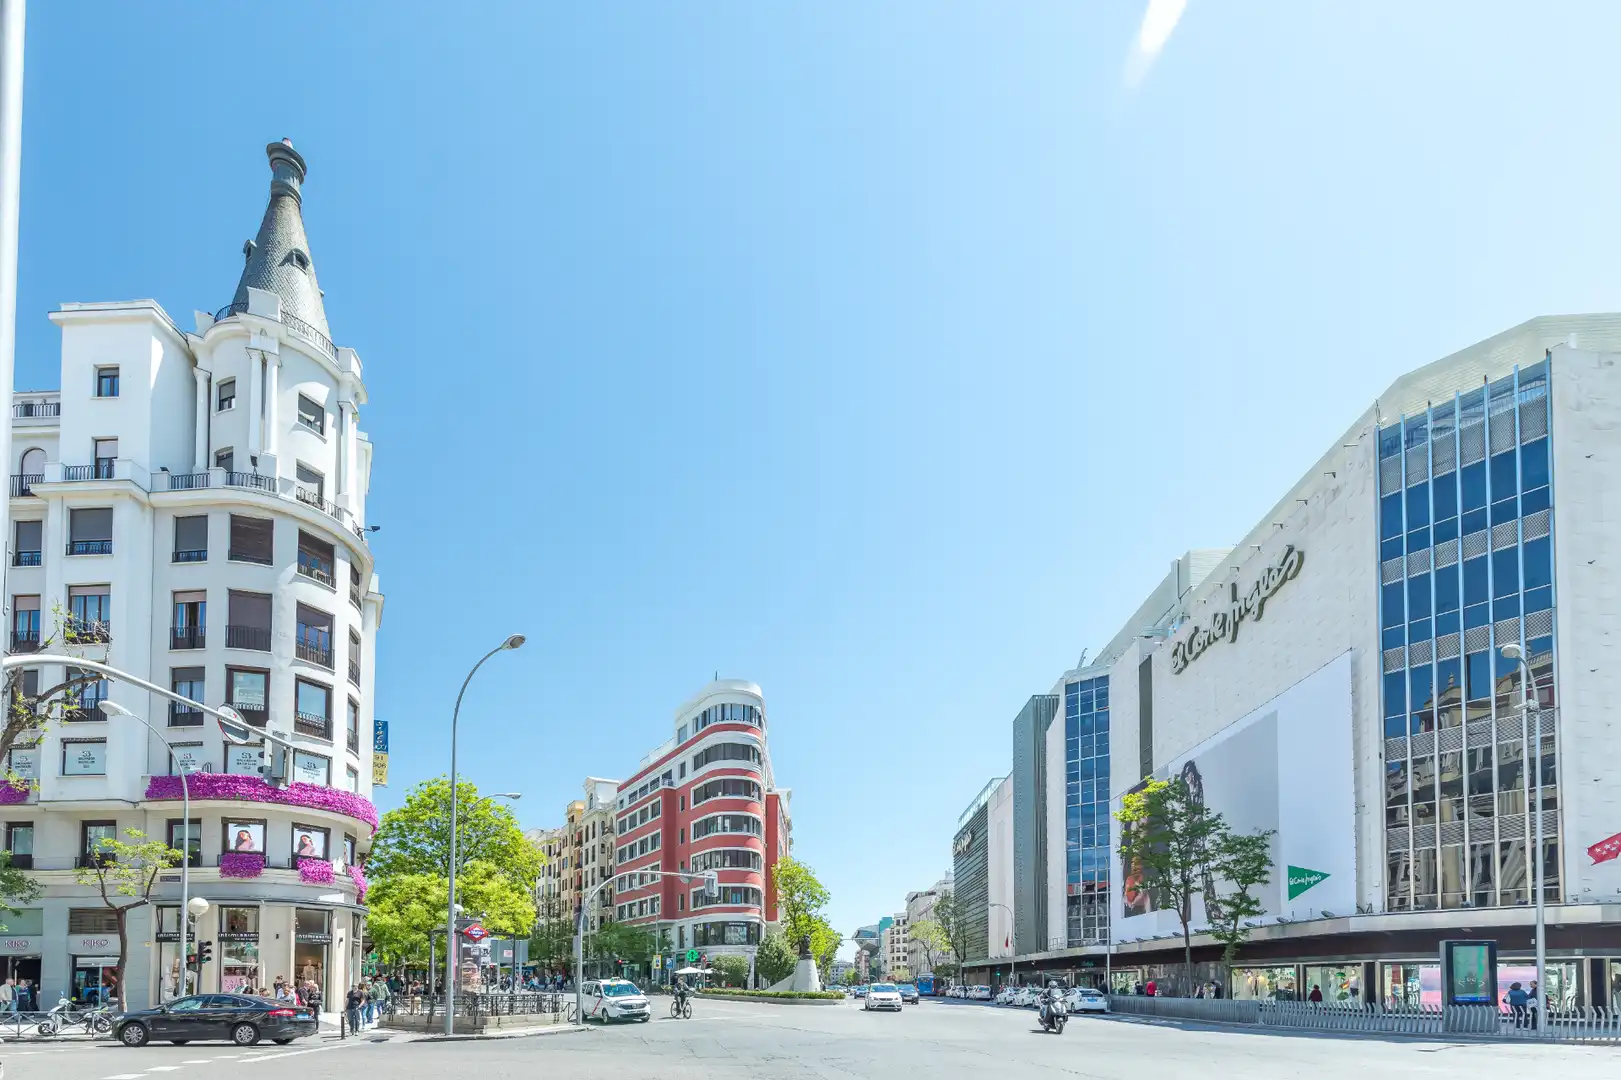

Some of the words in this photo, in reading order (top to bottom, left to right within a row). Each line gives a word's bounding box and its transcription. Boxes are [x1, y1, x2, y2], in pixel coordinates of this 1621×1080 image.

[1171, 640, 1189, 675] El
[1187, 612, 1228, 662] Corte
[5, 940, 31, 948] KIKO
